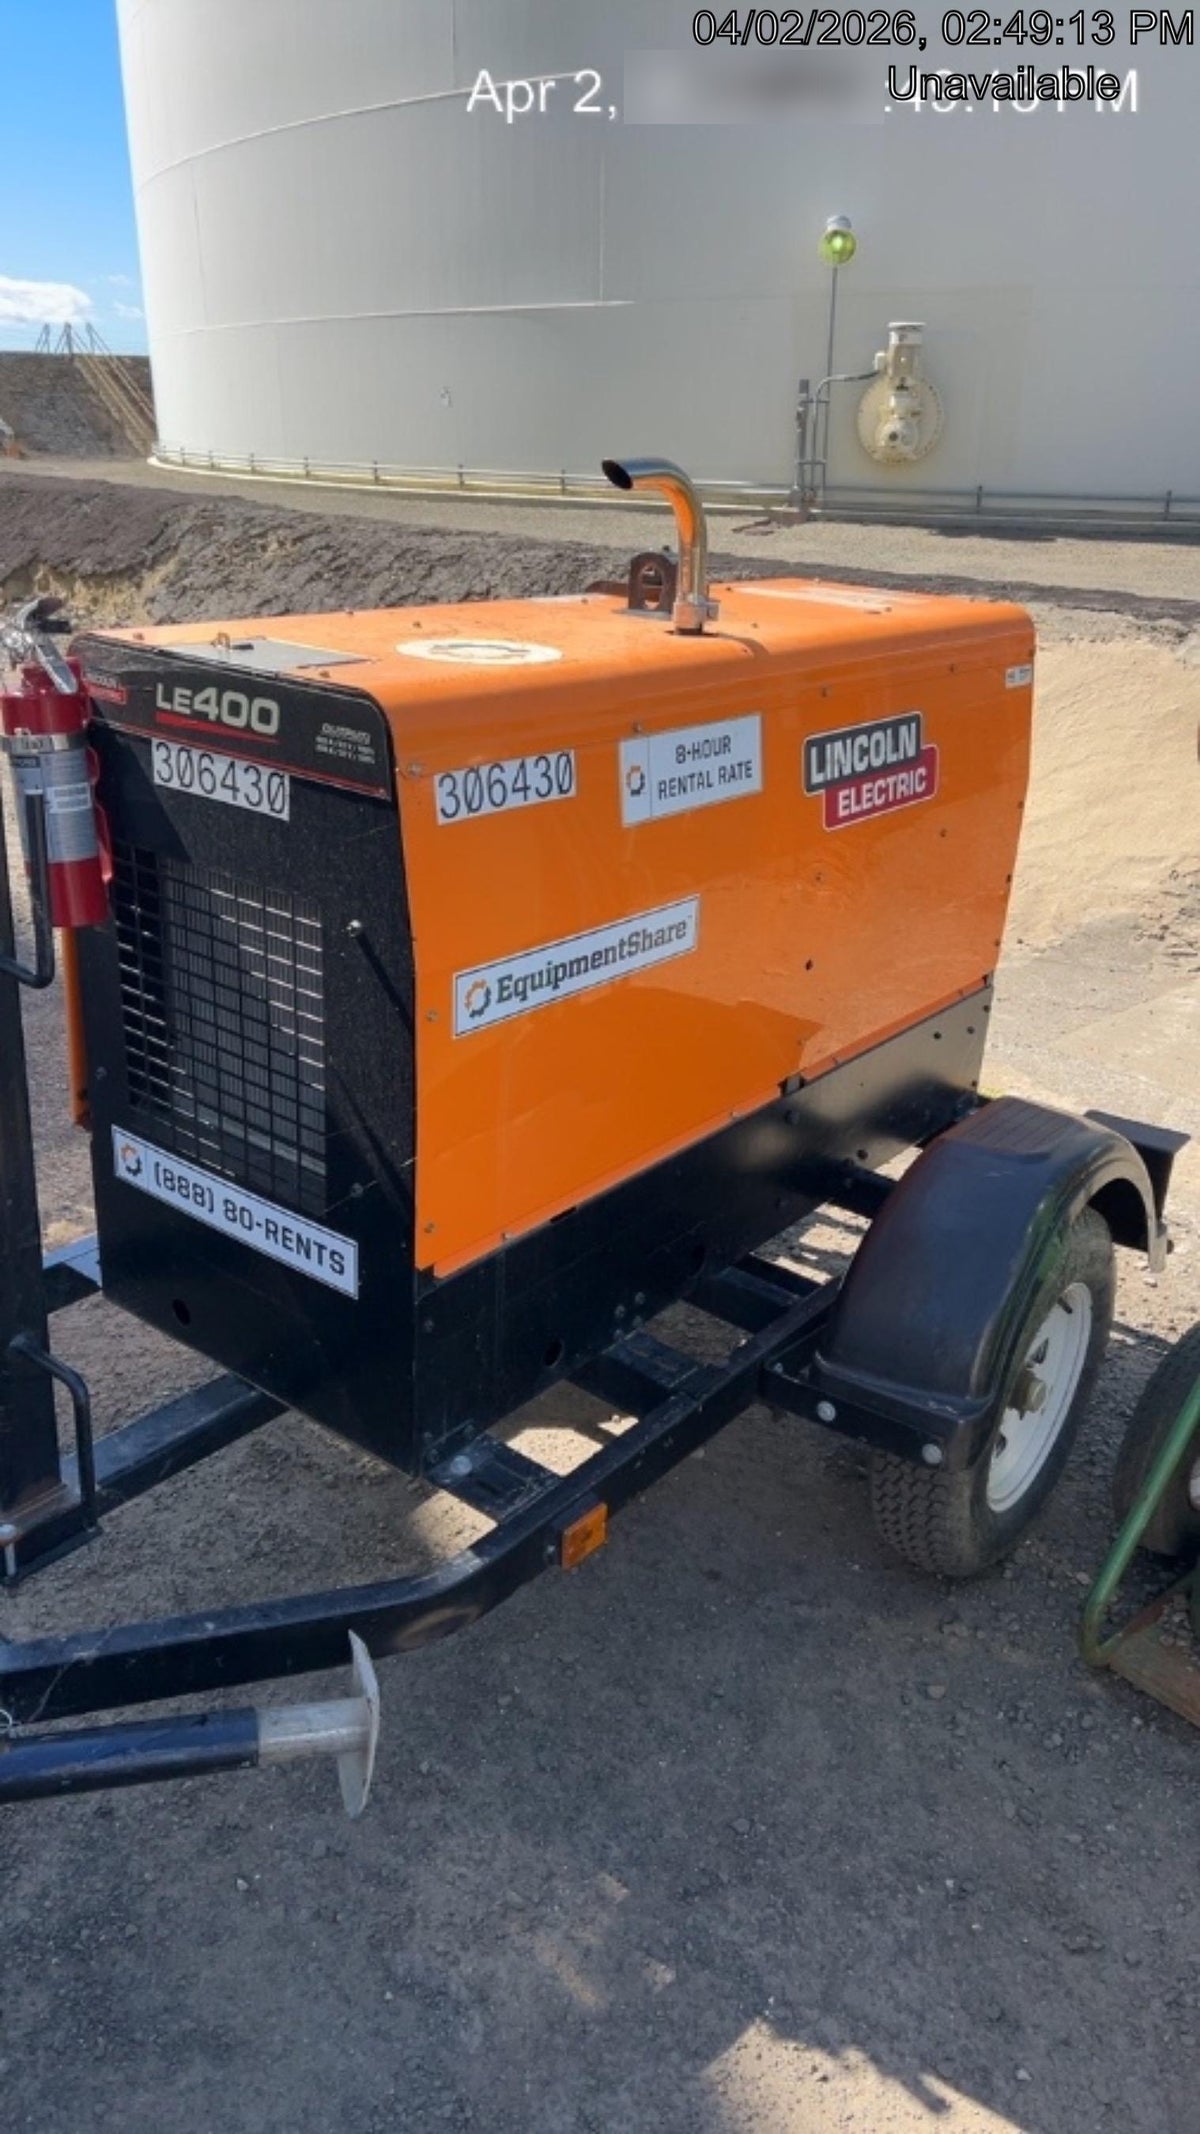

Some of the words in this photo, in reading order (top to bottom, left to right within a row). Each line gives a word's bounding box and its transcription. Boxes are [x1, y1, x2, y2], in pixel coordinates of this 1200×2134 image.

[155, 682, 279, 735] LE400
[155, 742, 287, 815] 306430
[657, 769, 714, 801] RENTAL
[718, 759, 753, 783] RATE
[675, 734, 732, 765] 8-HOUR
[809, 722, 917, 785] LINCOLN
[438, 751, 574, 819] 306430
[837, 767, 927, 818] ELECTRIC
[496, 919, 688, 1004] EquipmentShare
[153, 1160, 215, 1213] (888)
[222, 1197, 345, 1276] 80-RENTS
